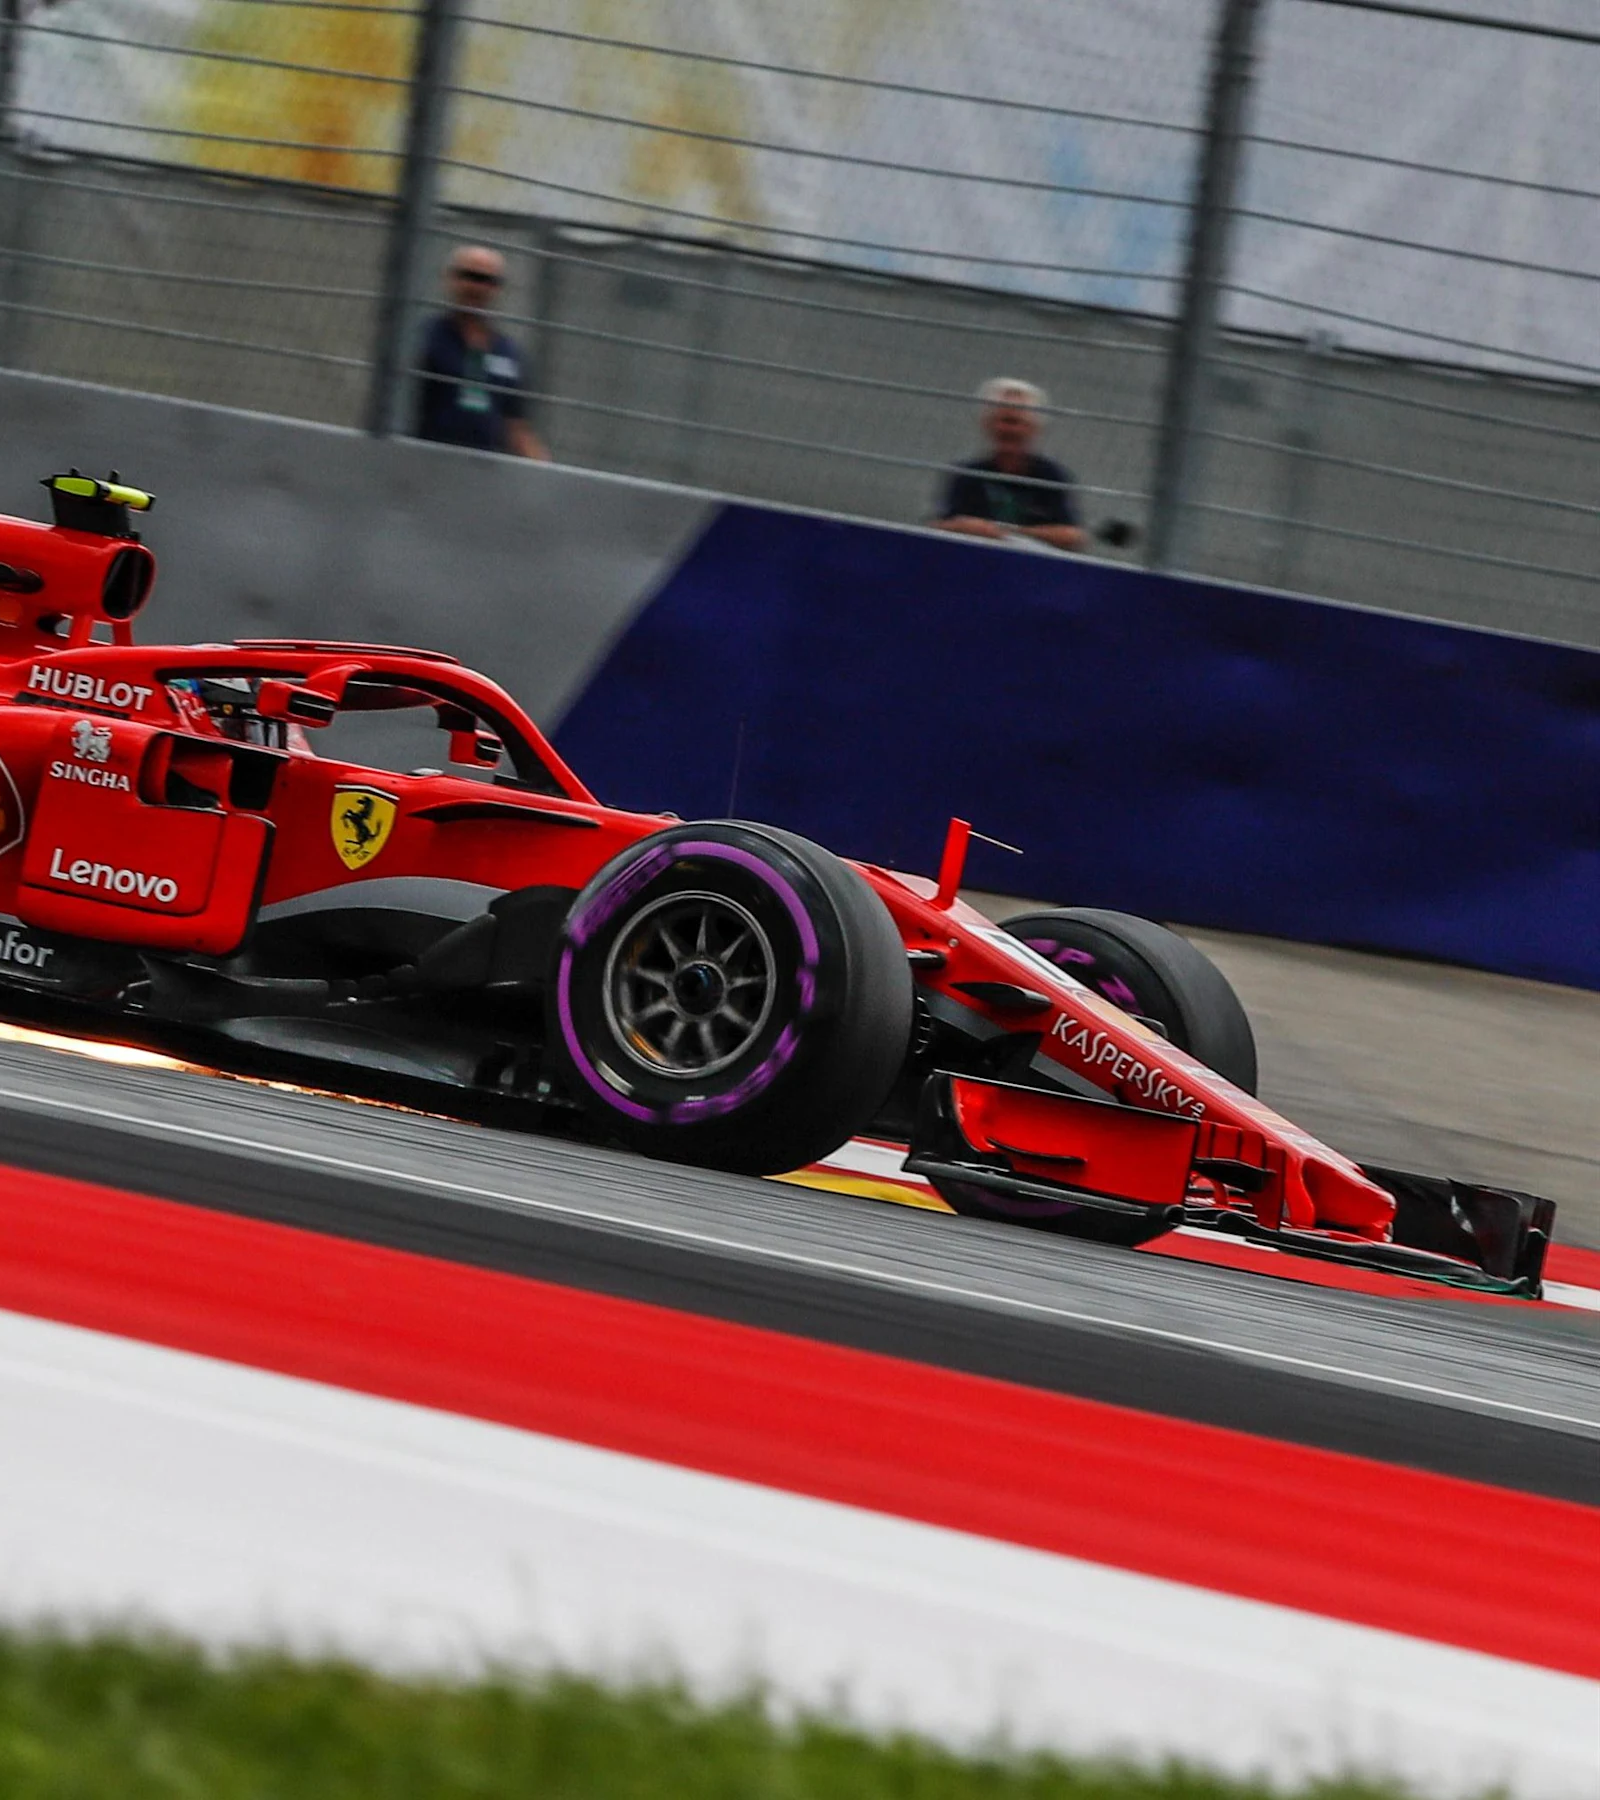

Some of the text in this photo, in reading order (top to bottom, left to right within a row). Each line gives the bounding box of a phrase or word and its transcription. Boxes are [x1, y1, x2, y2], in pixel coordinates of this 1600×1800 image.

[27, 664, 154, 712] HUBLOT
[49, 760, 131, 792] SINGHA
[49, 847, 179, 903] Lenovo
[1050, 1012, 1195, 1115] KASPERSKY
